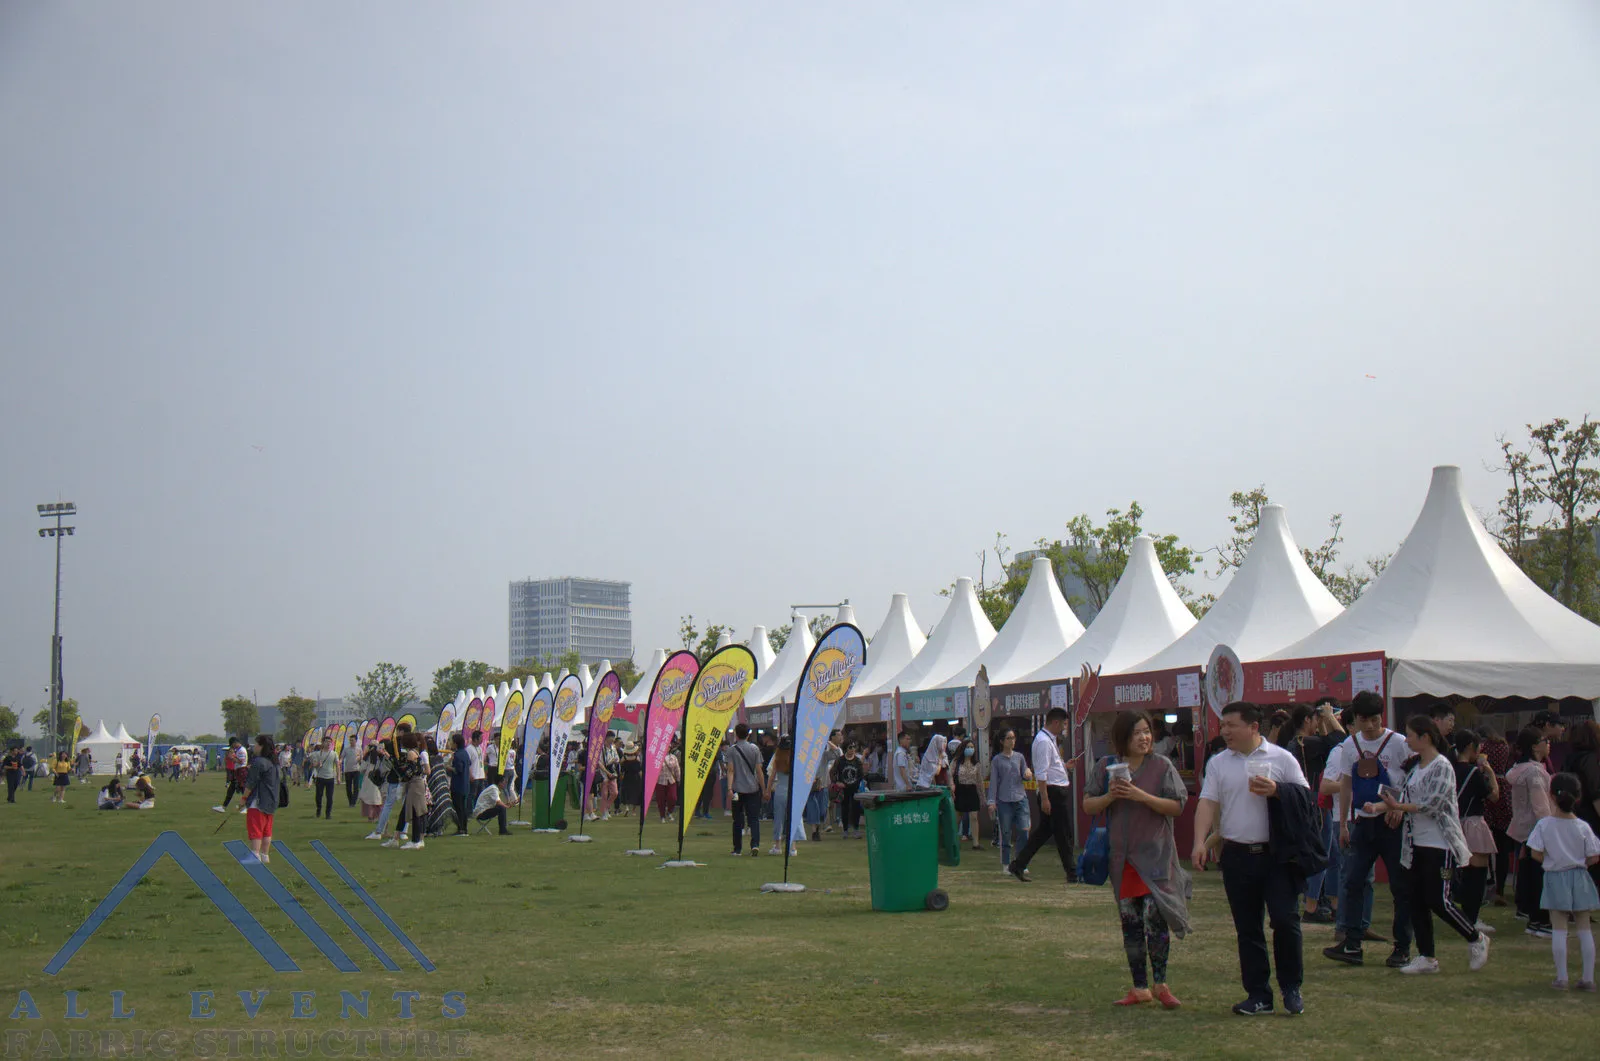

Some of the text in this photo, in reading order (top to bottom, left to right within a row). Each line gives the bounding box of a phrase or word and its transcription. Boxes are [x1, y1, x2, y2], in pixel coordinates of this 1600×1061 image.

[694, 667, 748, 708] Sun Music
[1263, 668, 1314, 692] 重庆酸辣粉
[688, 732, 707, 763] 滴水湖
[697, 726, 722, 780] 阳光音乐节
